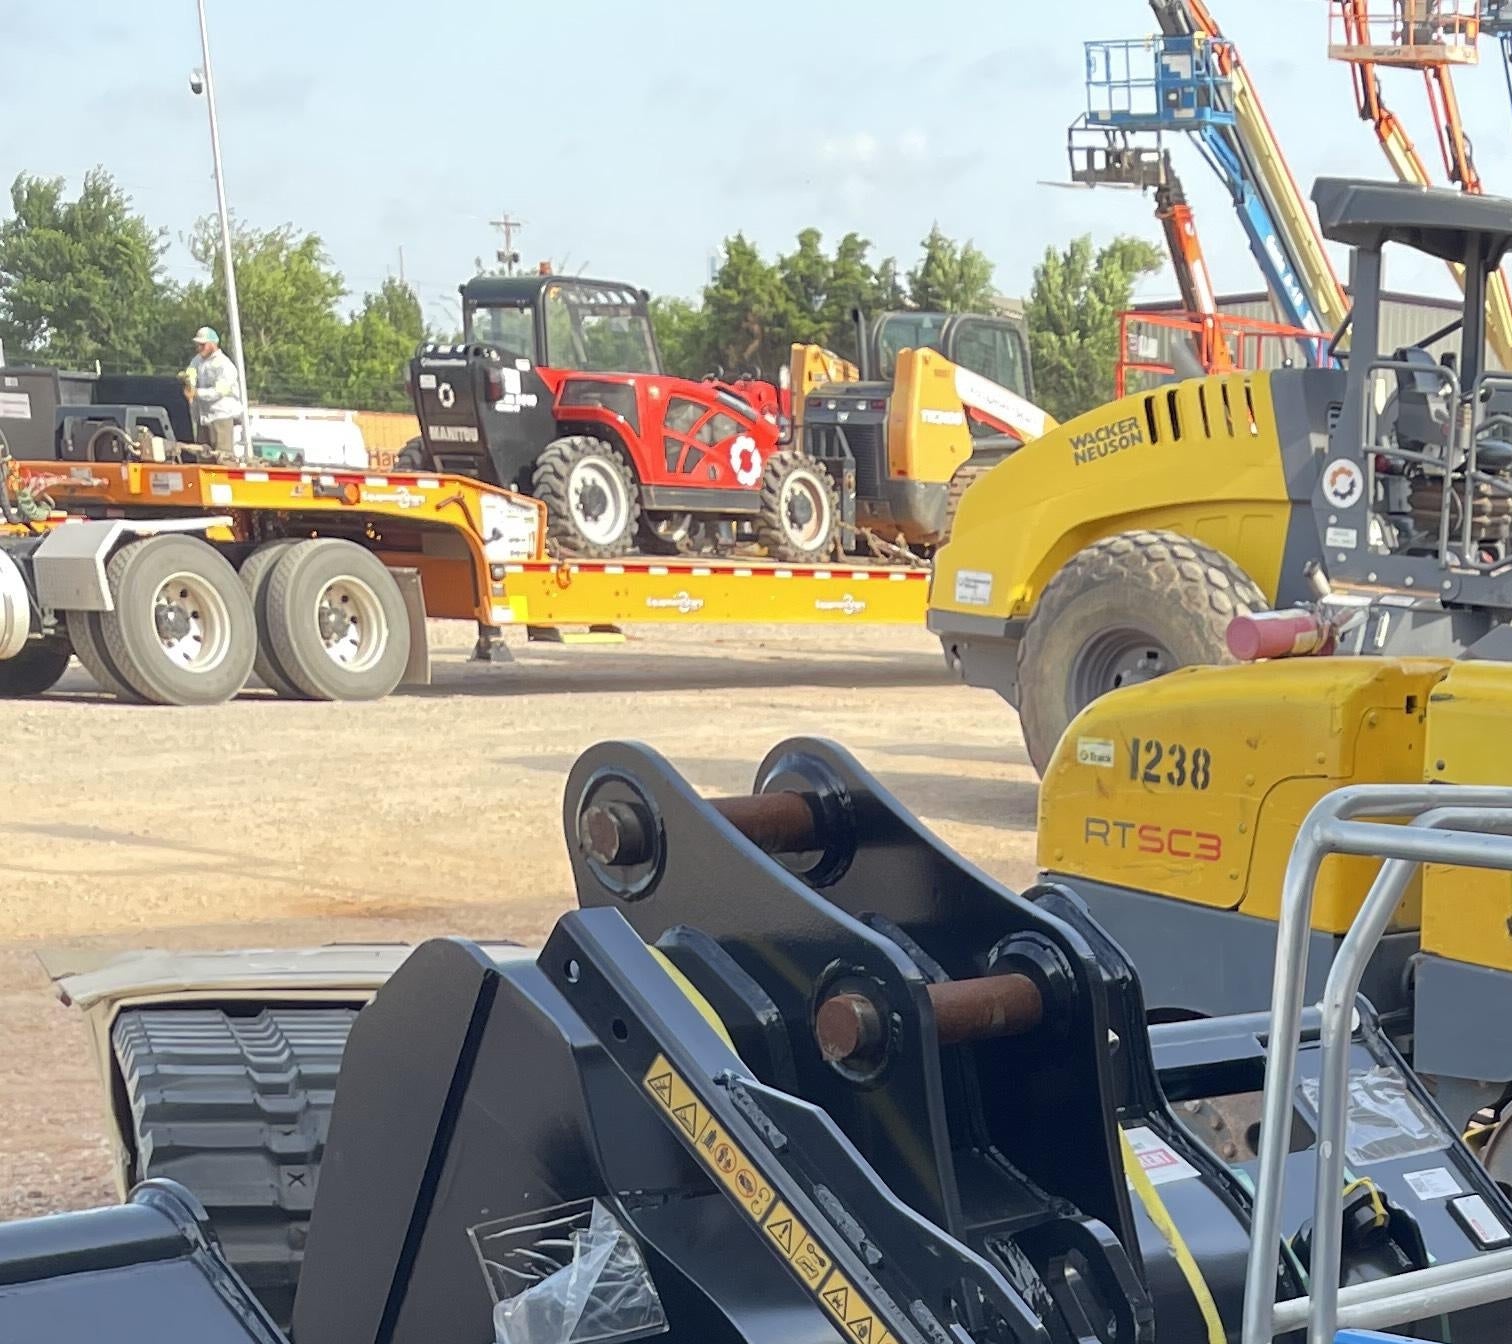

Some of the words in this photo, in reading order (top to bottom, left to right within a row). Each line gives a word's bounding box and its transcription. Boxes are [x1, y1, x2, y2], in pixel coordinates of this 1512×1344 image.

[1069, 416, 1139, 450] WACKER
[1074, 430, 1143, 466] NEUSON
[1130, 737, 1211, 790] 1238
